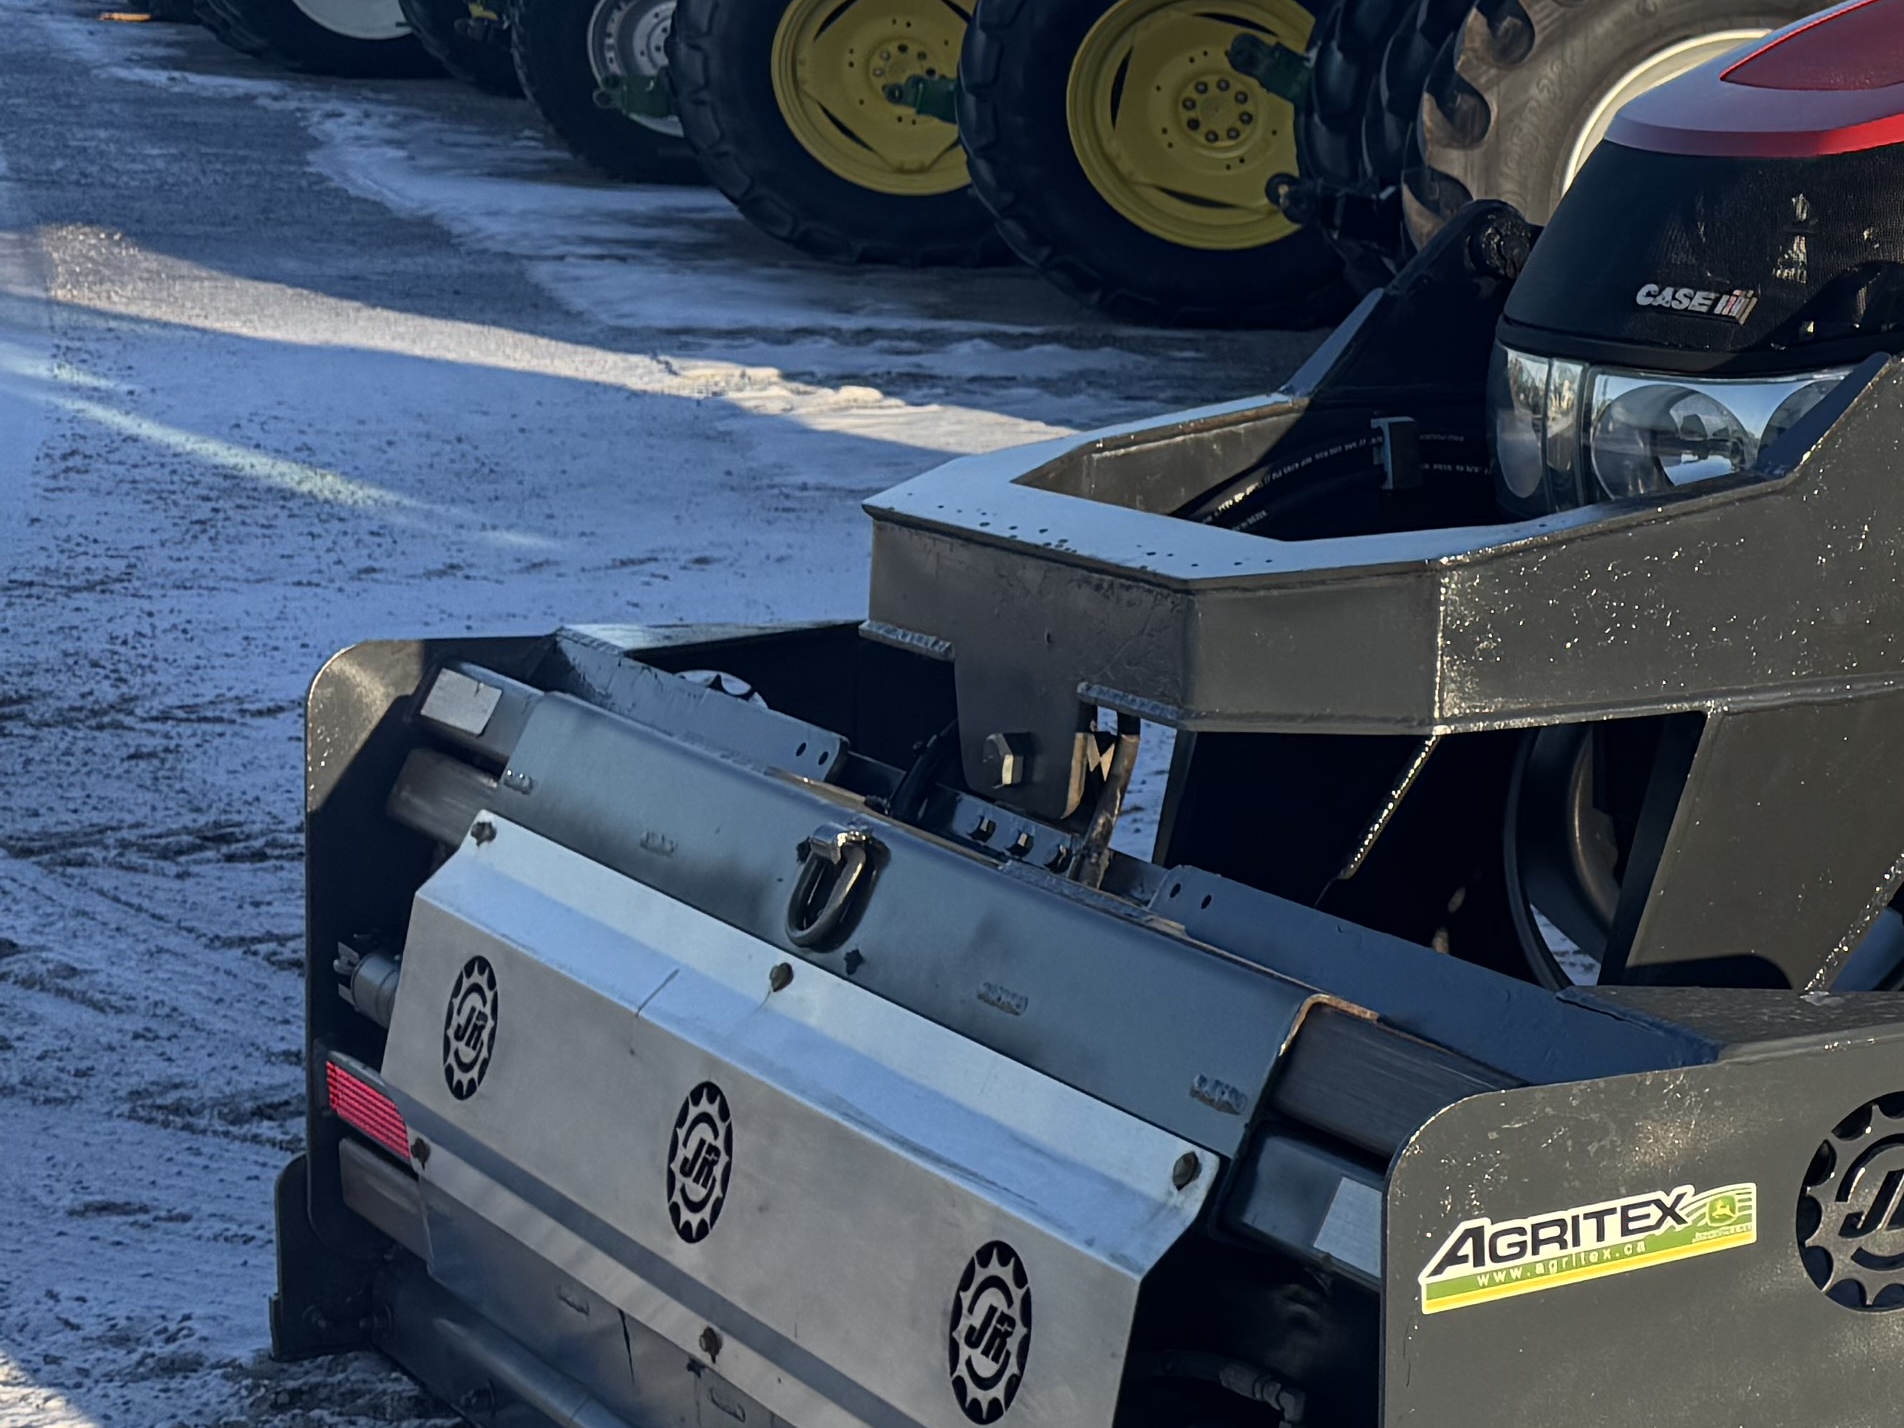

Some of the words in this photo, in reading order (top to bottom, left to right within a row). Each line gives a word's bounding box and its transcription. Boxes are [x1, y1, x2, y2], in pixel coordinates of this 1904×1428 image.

[1636, 283, 1720, 313] CASE
[1426, 1191, 1690, 1278] AGRITEX
[1476, 1239, 1646, 1288] www.agritex.ca
